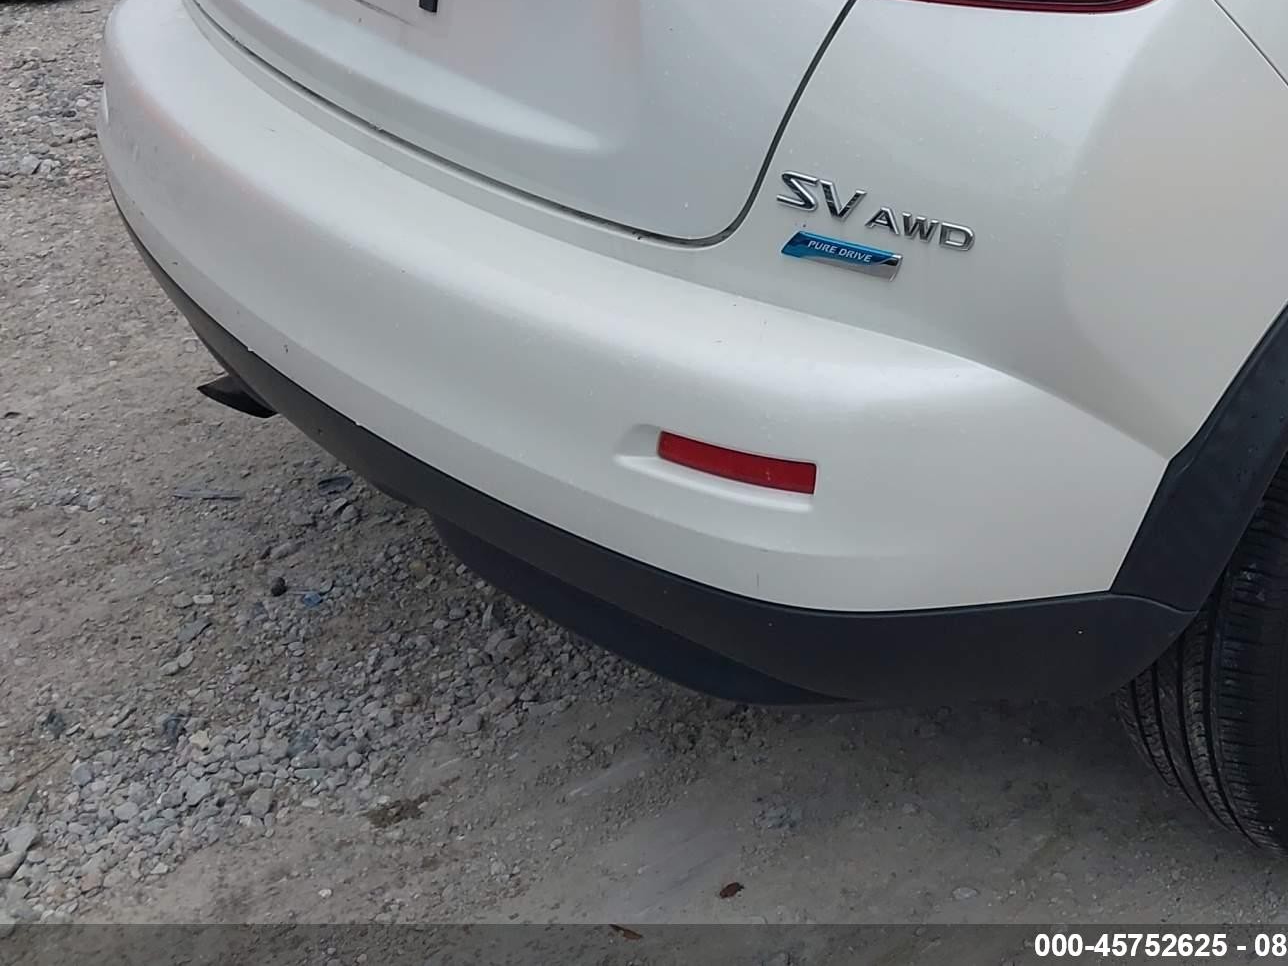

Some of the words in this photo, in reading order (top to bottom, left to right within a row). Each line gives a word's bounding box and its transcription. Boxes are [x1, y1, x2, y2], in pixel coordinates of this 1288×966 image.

[776, 170, 867, 221] SV
[864, 206, 976, 251] AWD
[807, 240, 838, 255] PURE
[838, 247, 873, 263] DRIVE
